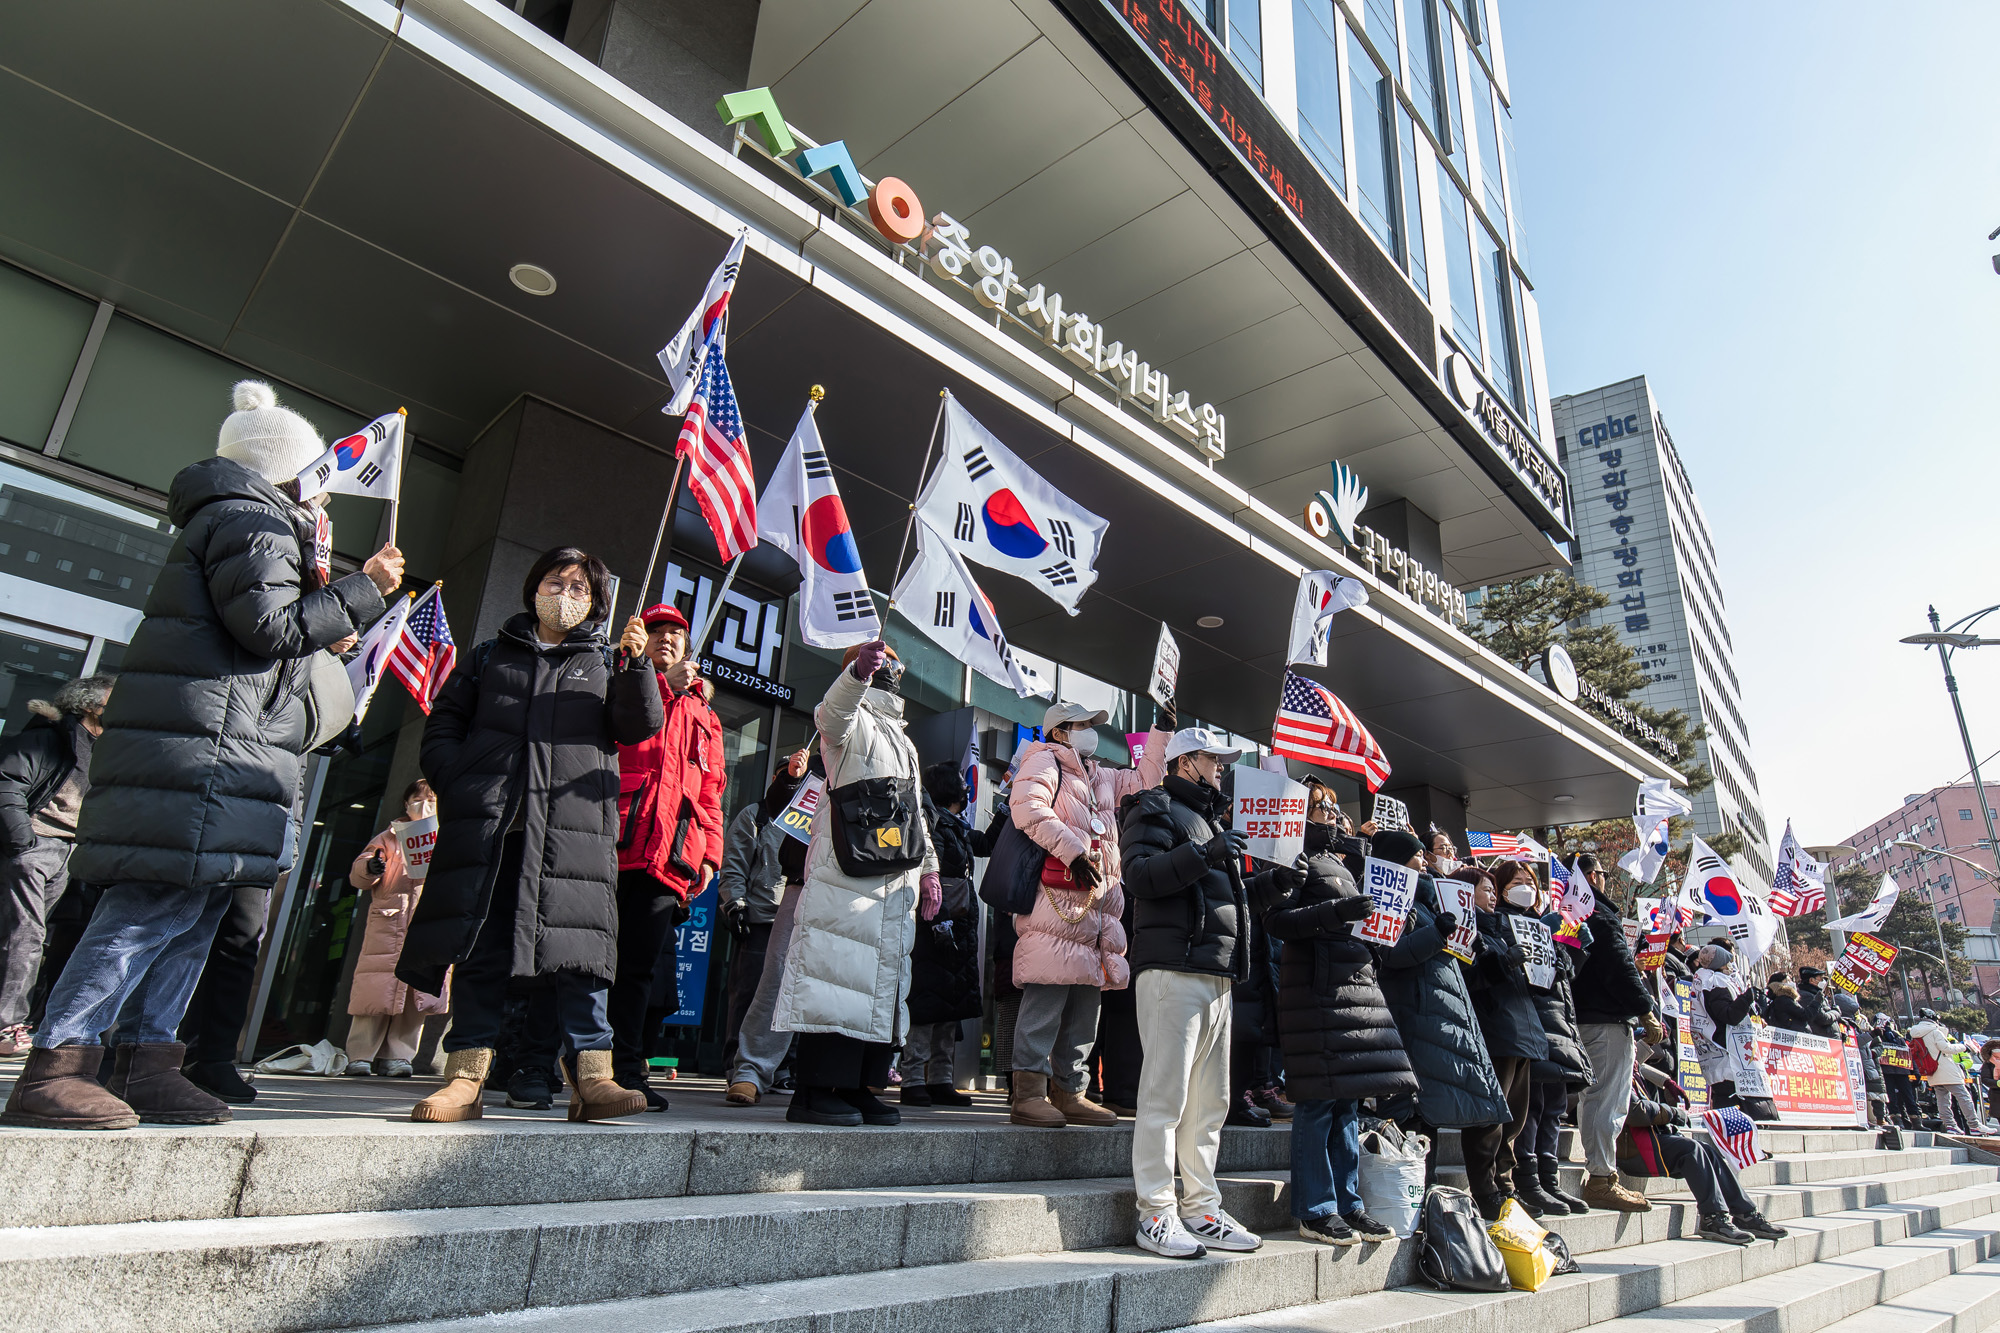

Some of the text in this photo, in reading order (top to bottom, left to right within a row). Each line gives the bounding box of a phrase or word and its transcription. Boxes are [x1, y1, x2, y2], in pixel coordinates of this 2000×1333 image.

[1122, 0, 1304, 218] 본 수칙을 지켜주세요!
[1579, 414, 1639, 448] cpbc
[1361, 526, 1468, 626] 국가인권위원회
[697, 656, 791, 700] 원 02-2275-2580
[1240, 797, 1306, 815] 자유민주주의
[1246, 821, 1282, 839] 무조건
[1788, 1075, 1812, 1098] 불구속
